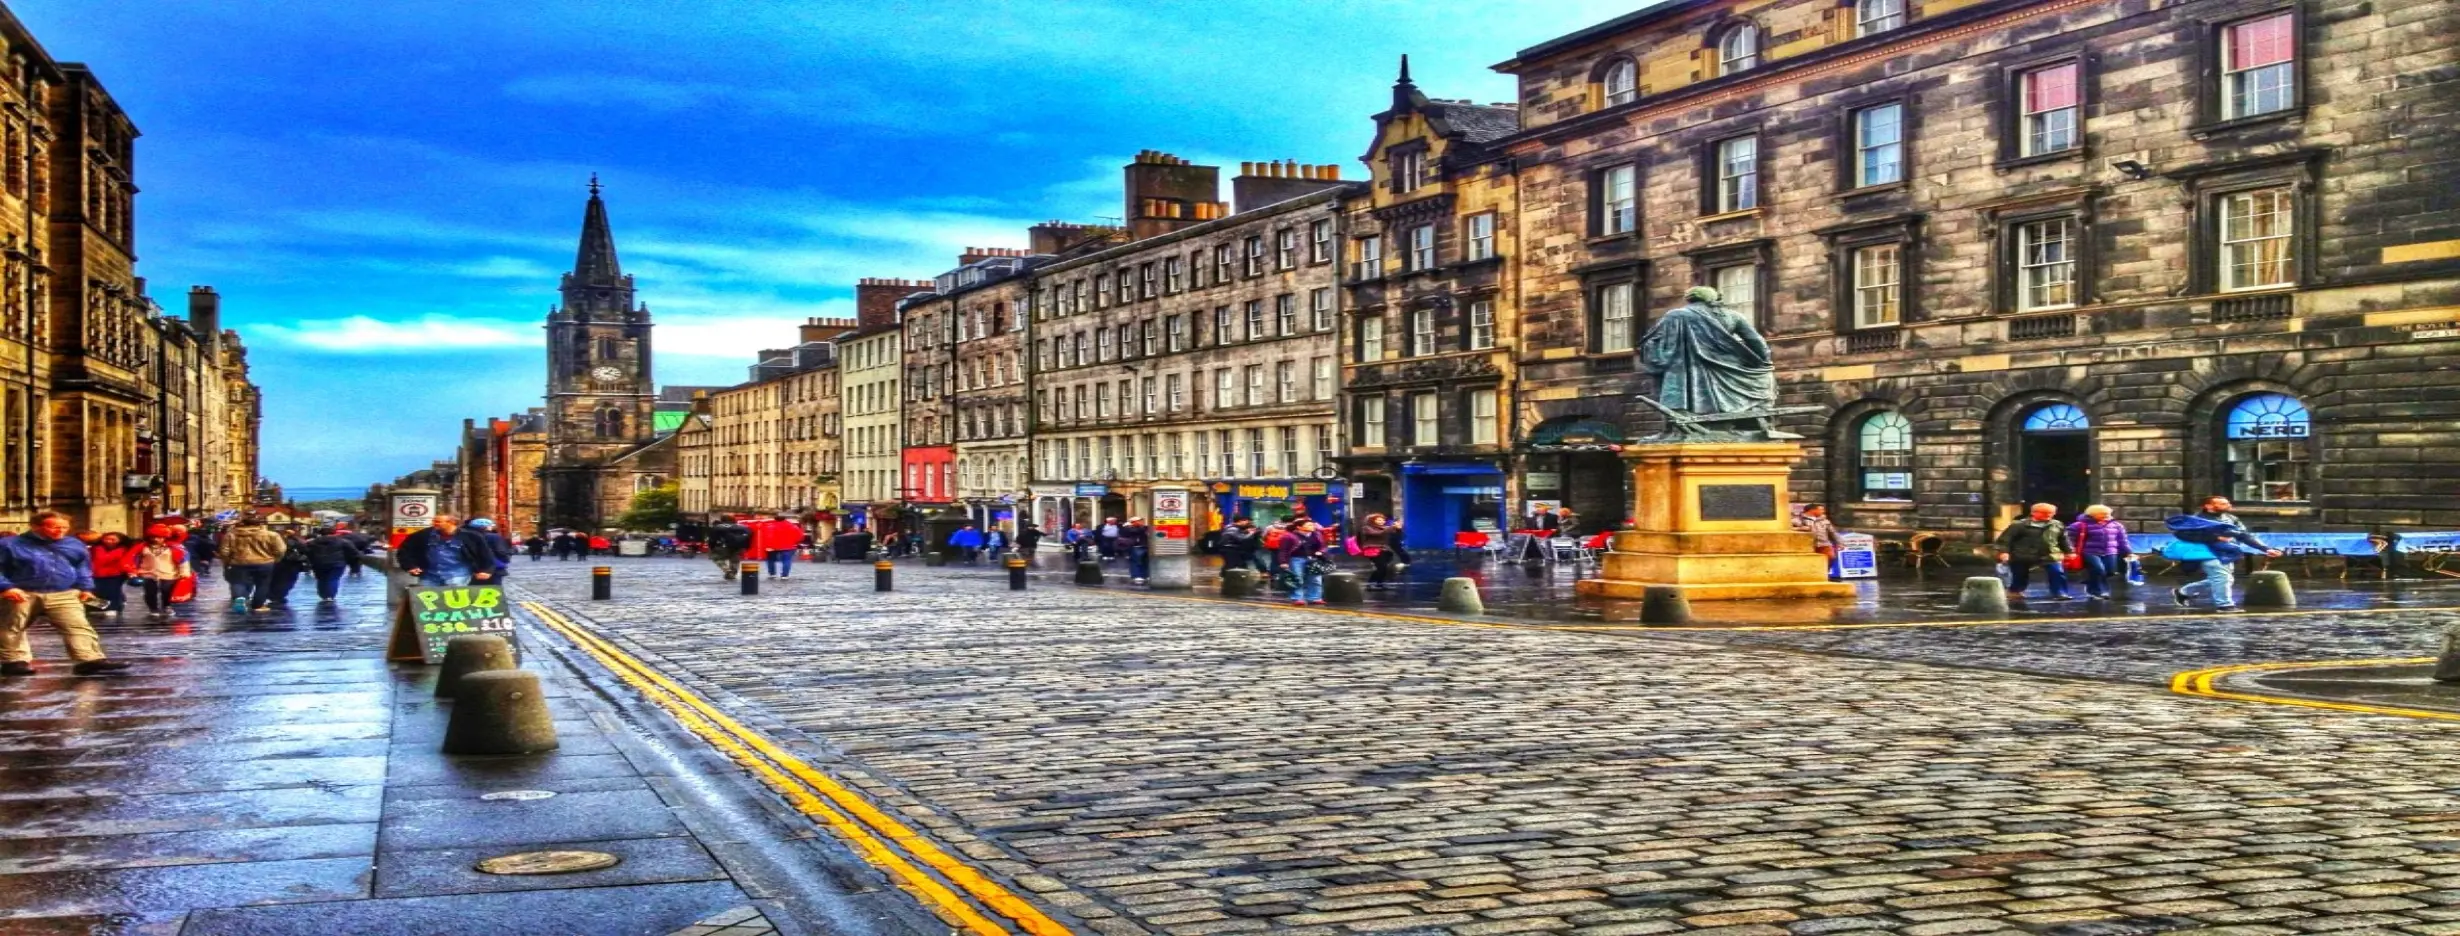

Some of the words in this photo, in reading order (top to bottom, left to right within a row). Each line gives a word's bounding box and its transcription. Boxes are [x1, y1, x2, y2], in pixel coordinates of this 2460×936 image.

[2240, 425, 2306, 436] NERO
[417, 587, 501, 610] PUB
[419, 607, 504, 622] CRAWL
